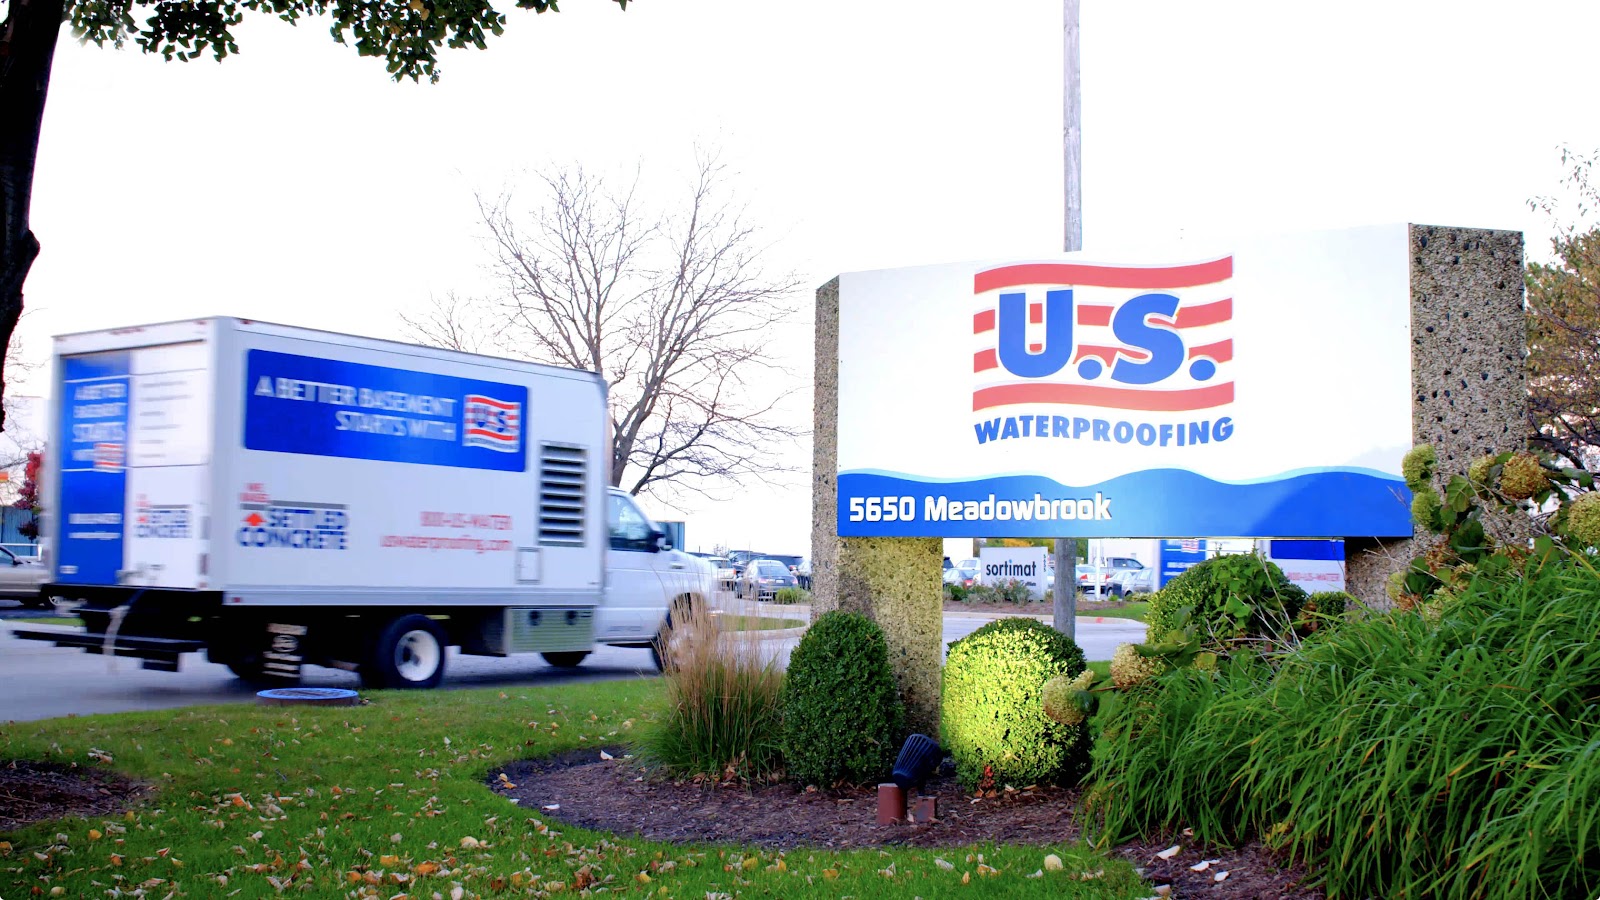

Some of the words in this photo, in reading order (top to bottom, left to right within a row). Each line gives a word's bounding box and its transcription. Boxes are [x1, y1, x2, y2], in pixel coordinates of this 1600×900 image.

[997, 288, 1217, 385] U.S.
[275, 377, 357, 406] BETTER
[358, 387, 458, 418] BASEMENT
[974, 415, 1235, 447] WATERPROOFING
[269, 508, 348, 529] SETTLED
[849, 494, 916, 523] 5650
[923, 491, 1112, 522] Meadowbrook
[237, 527, 348, 550] CONCRETE
[986, 559, 1036, 577] sortimat
